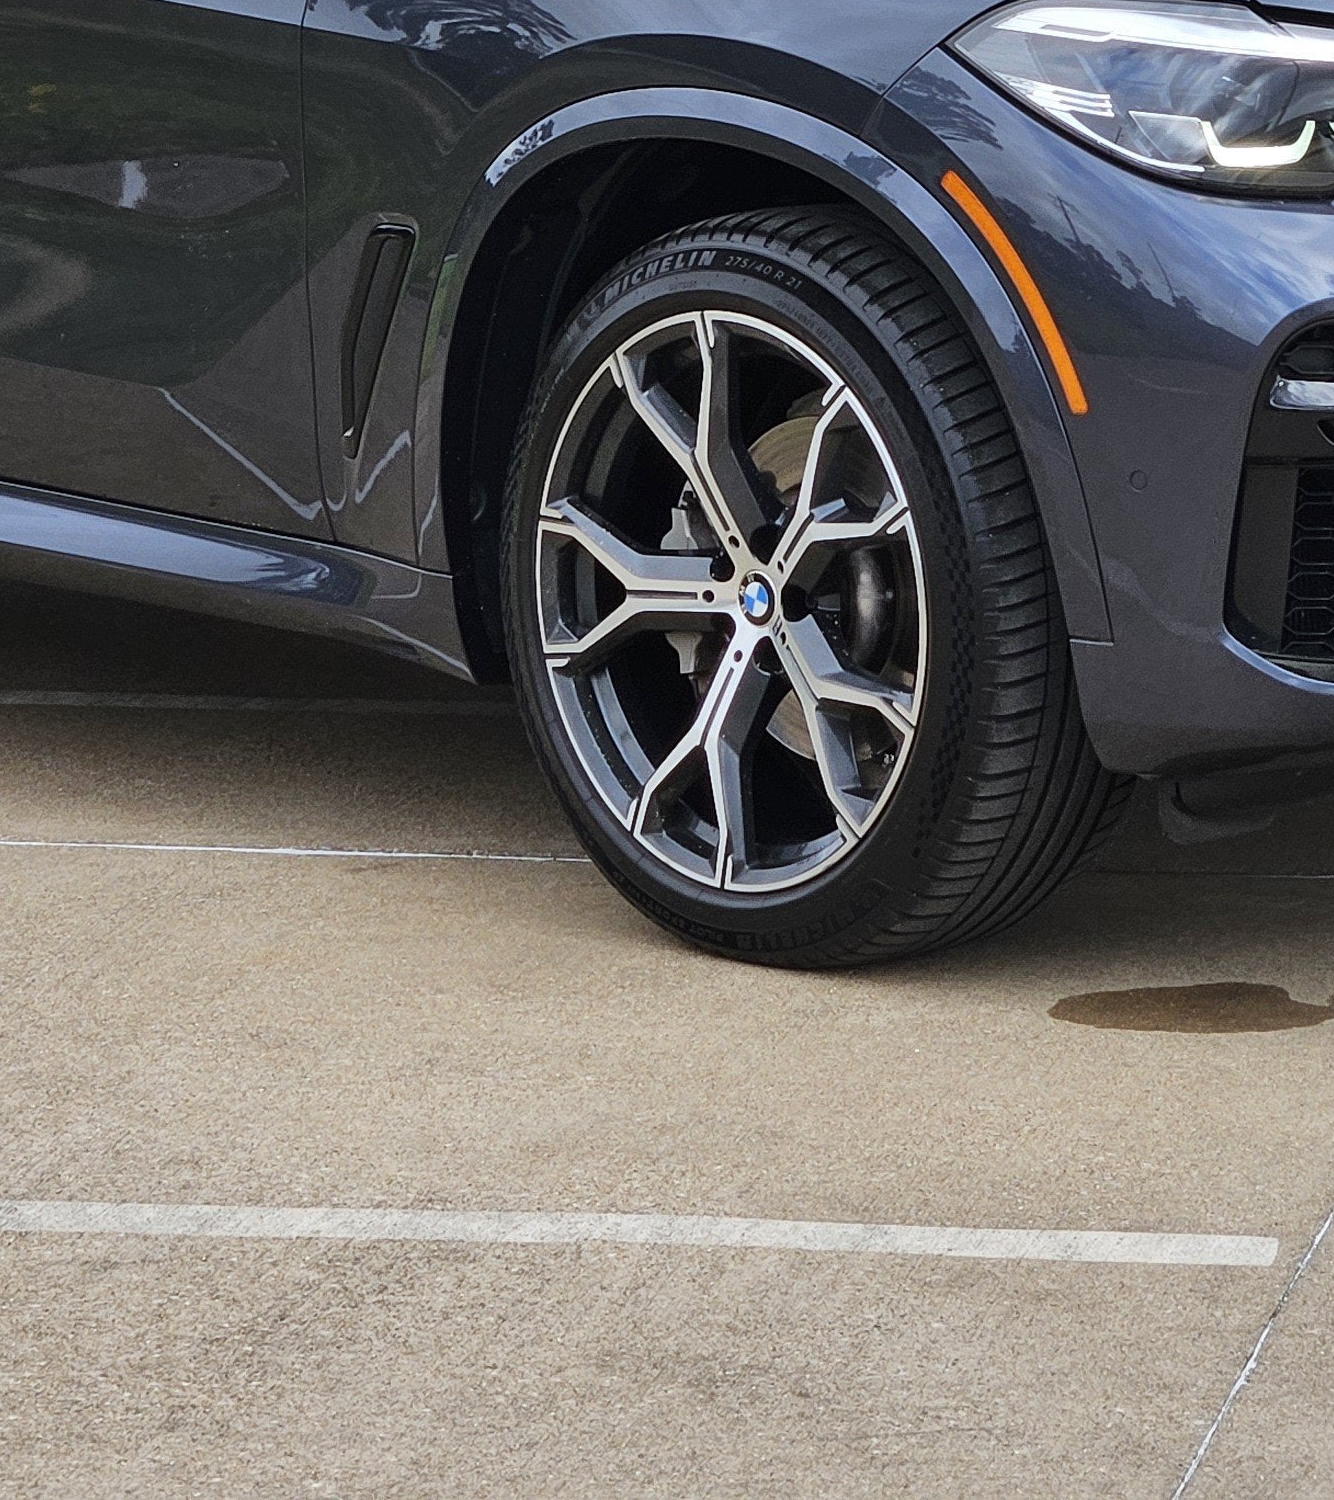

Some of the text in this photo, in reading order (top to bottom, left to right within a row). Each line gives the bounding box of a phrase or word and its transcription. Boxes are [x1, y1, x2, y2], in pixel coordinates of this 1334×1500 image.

[604, 250, 802, 305] MICHELIN 275/40 R 21
